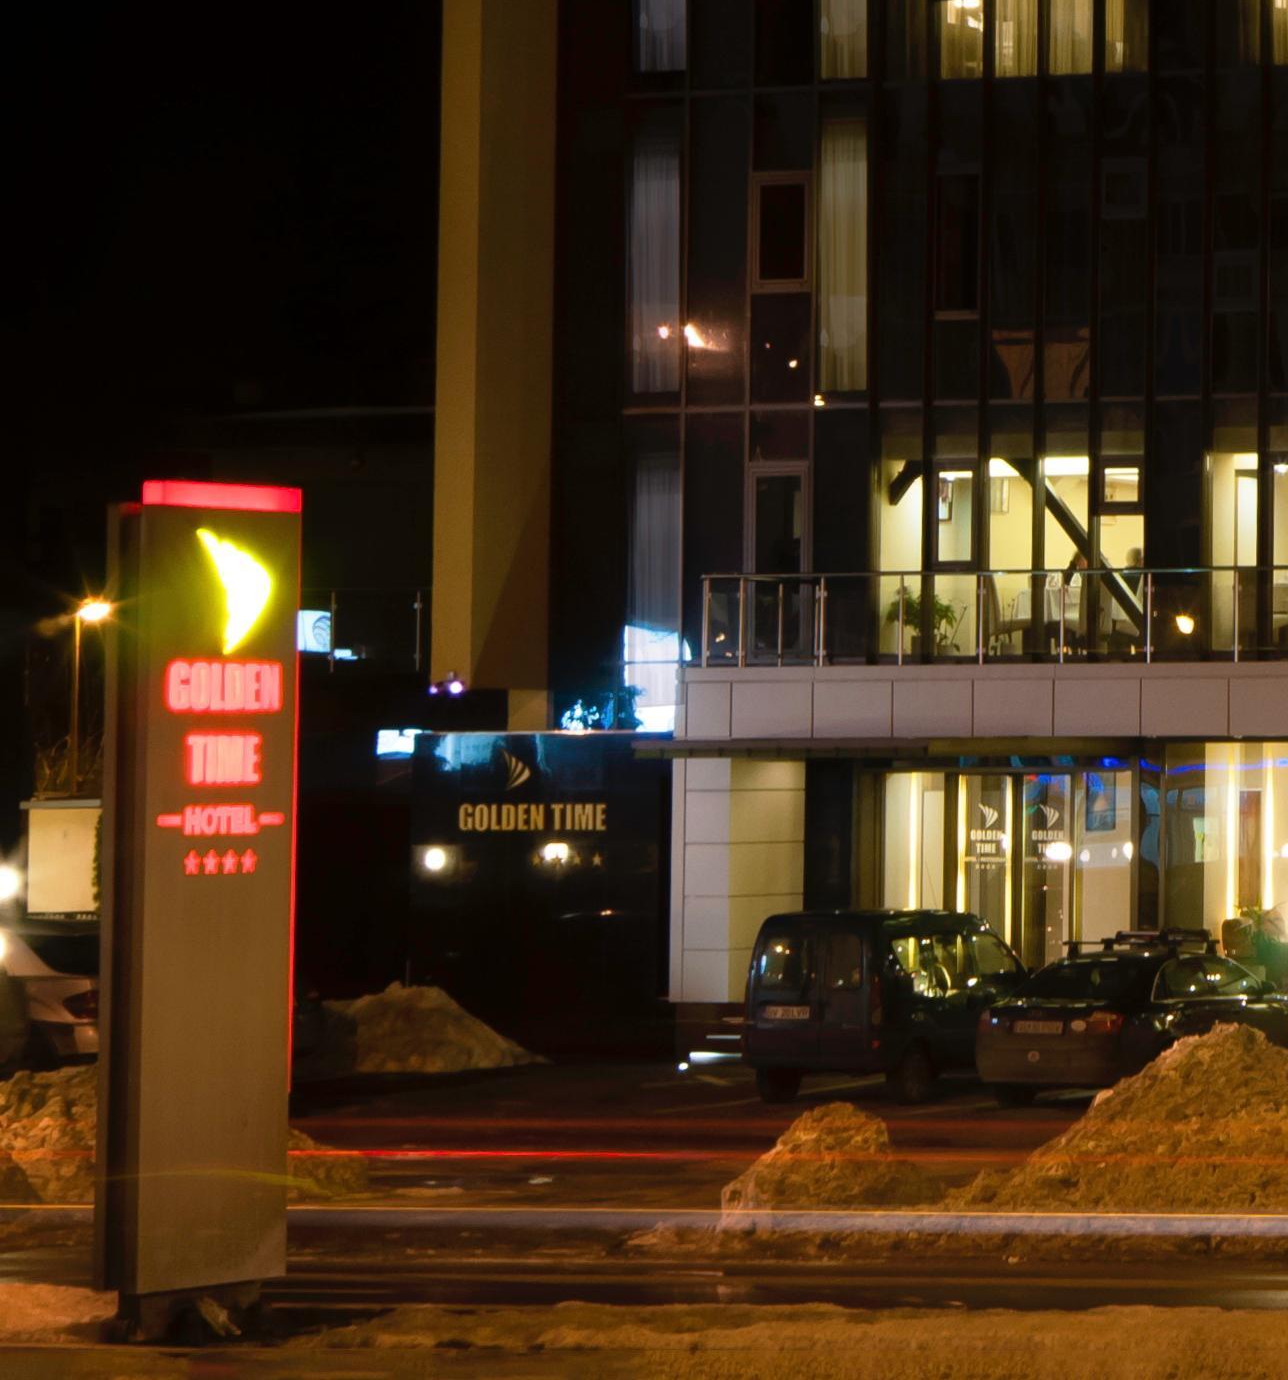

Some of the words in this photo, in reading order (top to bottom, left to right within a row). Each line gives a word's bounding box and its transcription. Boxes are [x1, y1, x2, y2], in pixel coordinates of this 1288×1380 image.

[167, 660, 282, 713] GOLDEN
[186, 733, 262, 785] TIME
[183, 805, 260, 835] HOTEL
[458, 803, 545, 831] GOLDEN
[551, 803, 606, 831] TIME
[976, 843, 996, 854] TIME
[1032, 829, 1064, 841] GOLDEN
